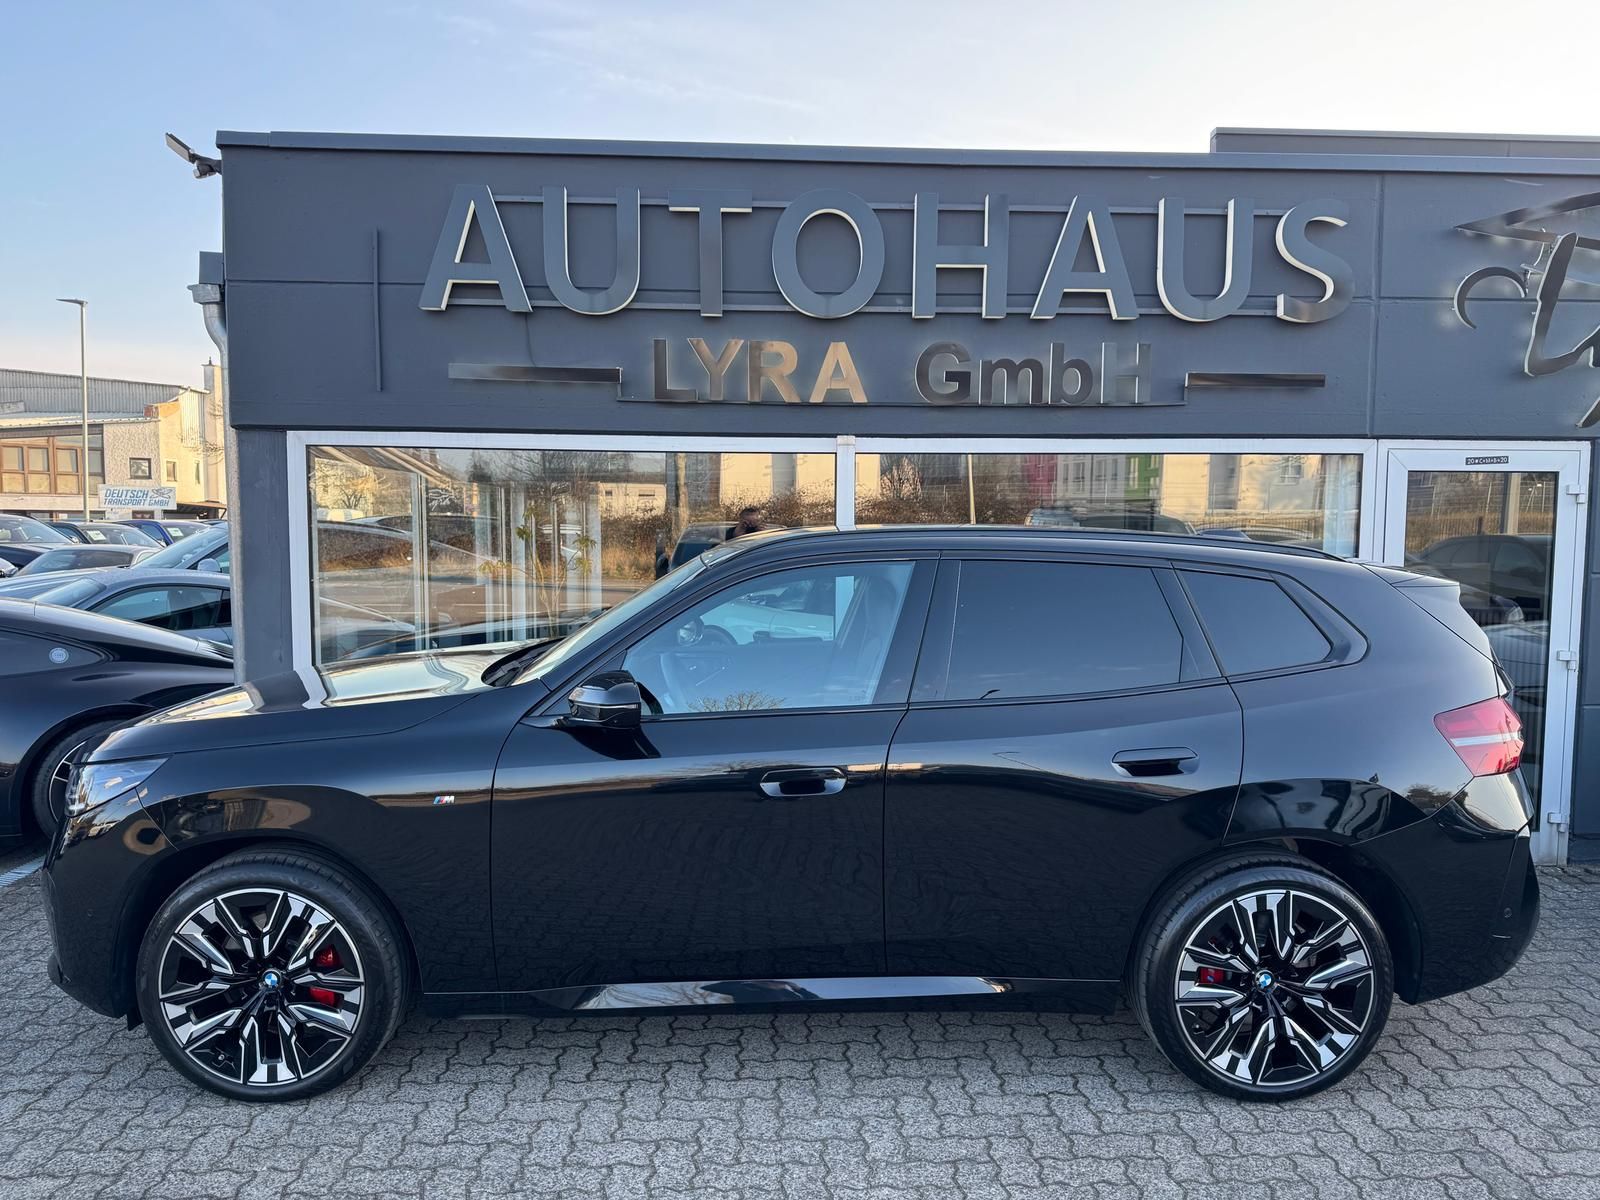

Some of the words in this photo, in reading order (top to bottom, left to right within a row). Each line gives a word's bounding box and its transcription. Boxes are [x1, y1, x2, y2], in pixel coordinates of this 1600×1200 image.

[418, 184, 1356, 324] AUTOHAUS
[652, 338, 868, 404] LYRA
[914, 341, 1152, 406] GmbH
[103, 498, 146, 506] TRANSPORT
[104, 488, 149, 498] DEUTSCH
